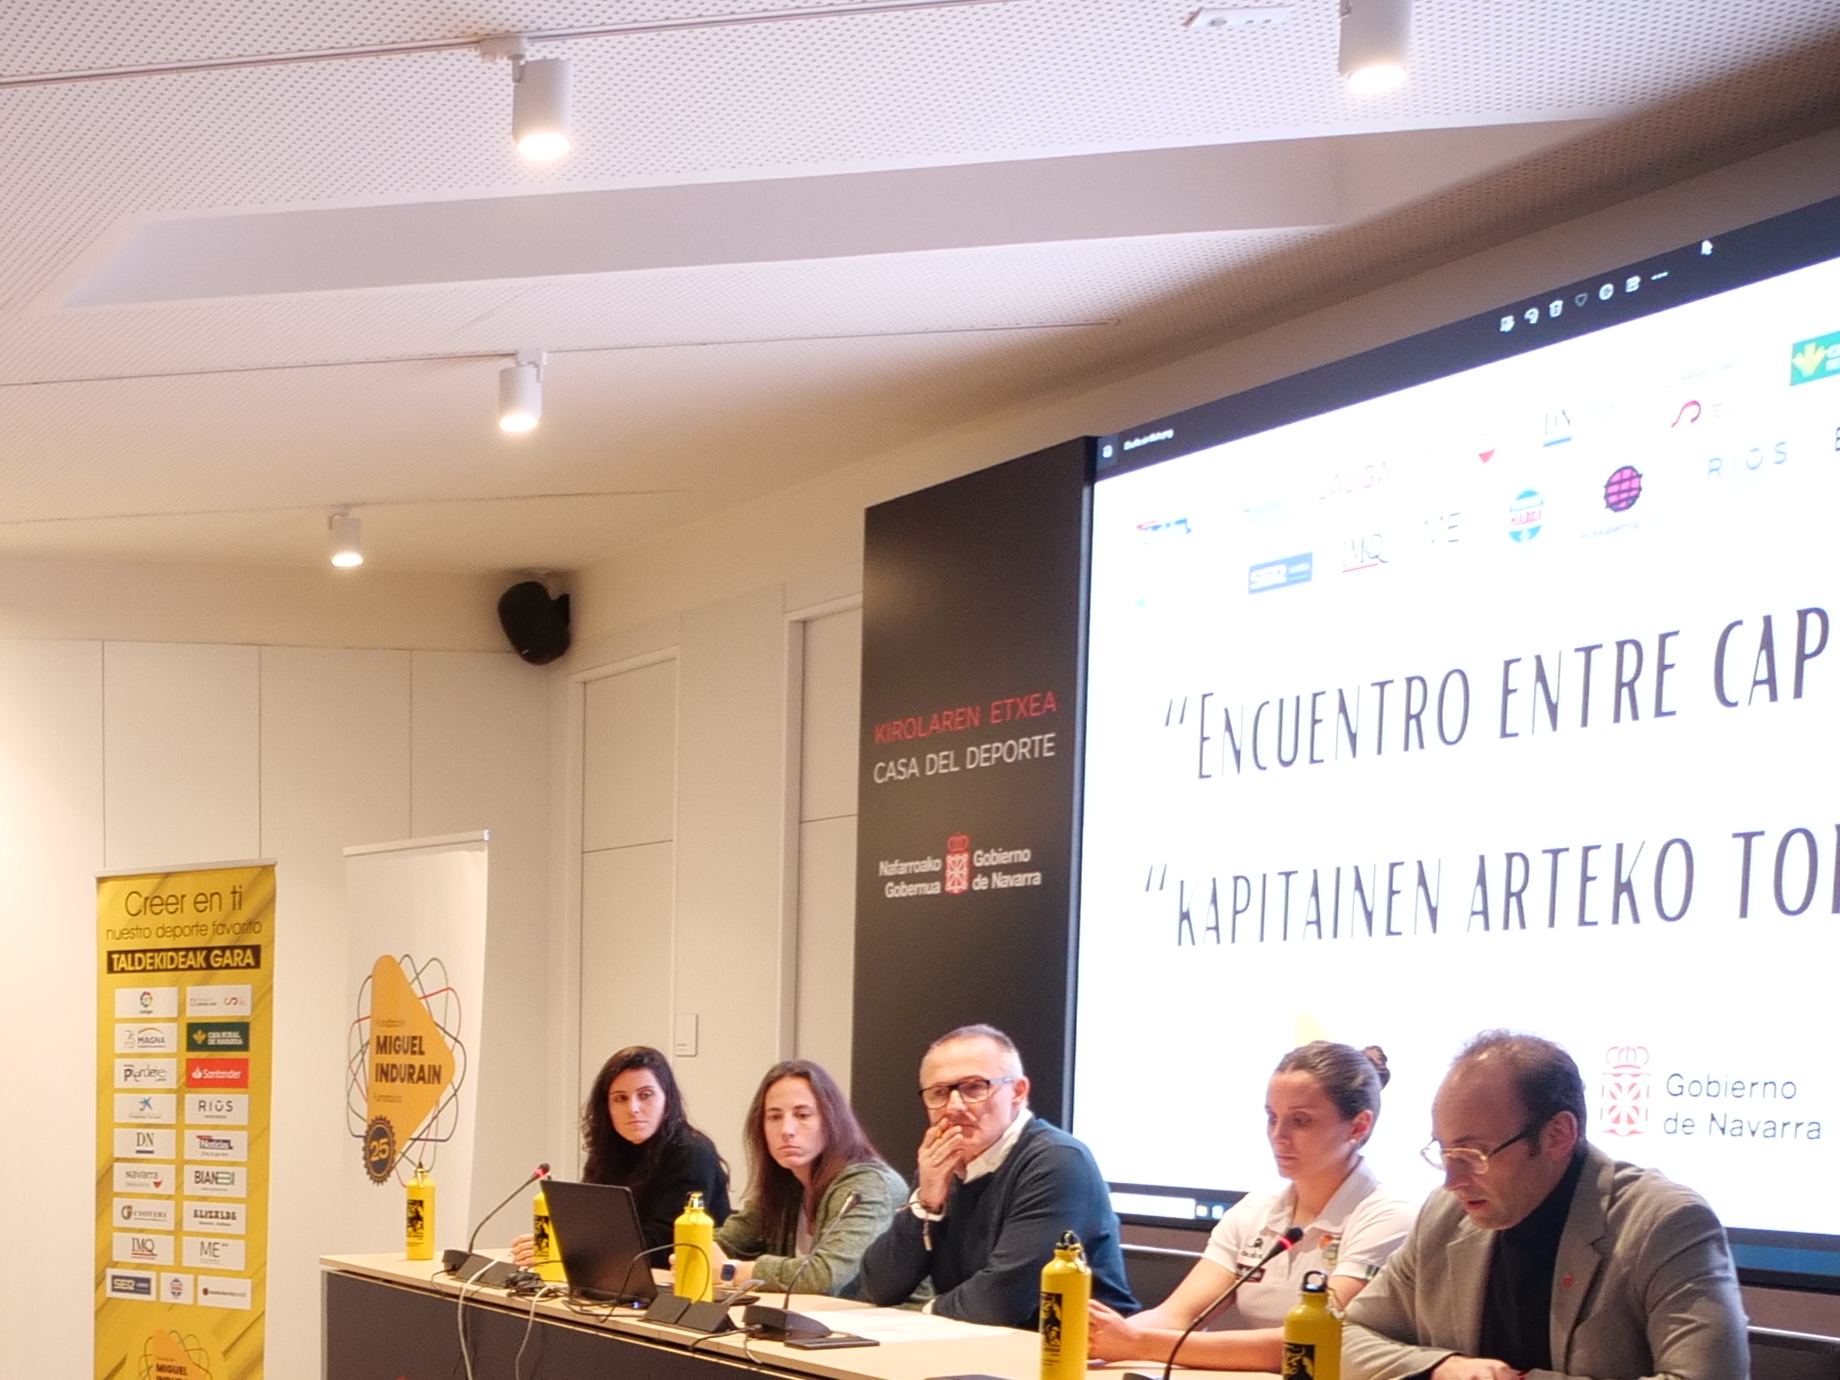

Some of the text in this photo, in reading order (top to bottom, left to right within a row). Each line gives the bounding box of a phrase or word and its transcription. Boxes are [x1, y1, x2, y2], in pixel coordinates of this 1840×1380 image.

[1499, 629, 1681, 740] ENTRE
[1712, 606, 1831, 709] CAP
[874, 689, 1059, 744] KIROLAREN ETXEA
[873, 732, 1057, 784] CASA DEL DEPORTE
[878, 856, 942, 877] Nafarroako
[973, 848, 1031, 868] Gobierno
[884, 880, 941, 899] Gobernua
[971, 871, 1042, 891] de Navarra
[1466, 836, 1696, 933] ARTEKO
[124, 884, 243, 917] Creer en ti
[106, 919, 263, 941] nuestro deporte favorito
[111, 948, 256, 972] TALDEKIDEAK GARA
[375, 1035, 426, 1056] MIGUEL
[202, 1068, 242, 1080] Santander
[374, 1063, 442, 1085] INDURAIN
[1666, 1073, 1798, 1100] Gobierno
[1663, 1112, 1822, 1141] de Navarra
[135, 1132, 155, 1147] DN
[370, 1137, 390, 1162] 25
[155, 1363, 188, 1376] MIGUEL
